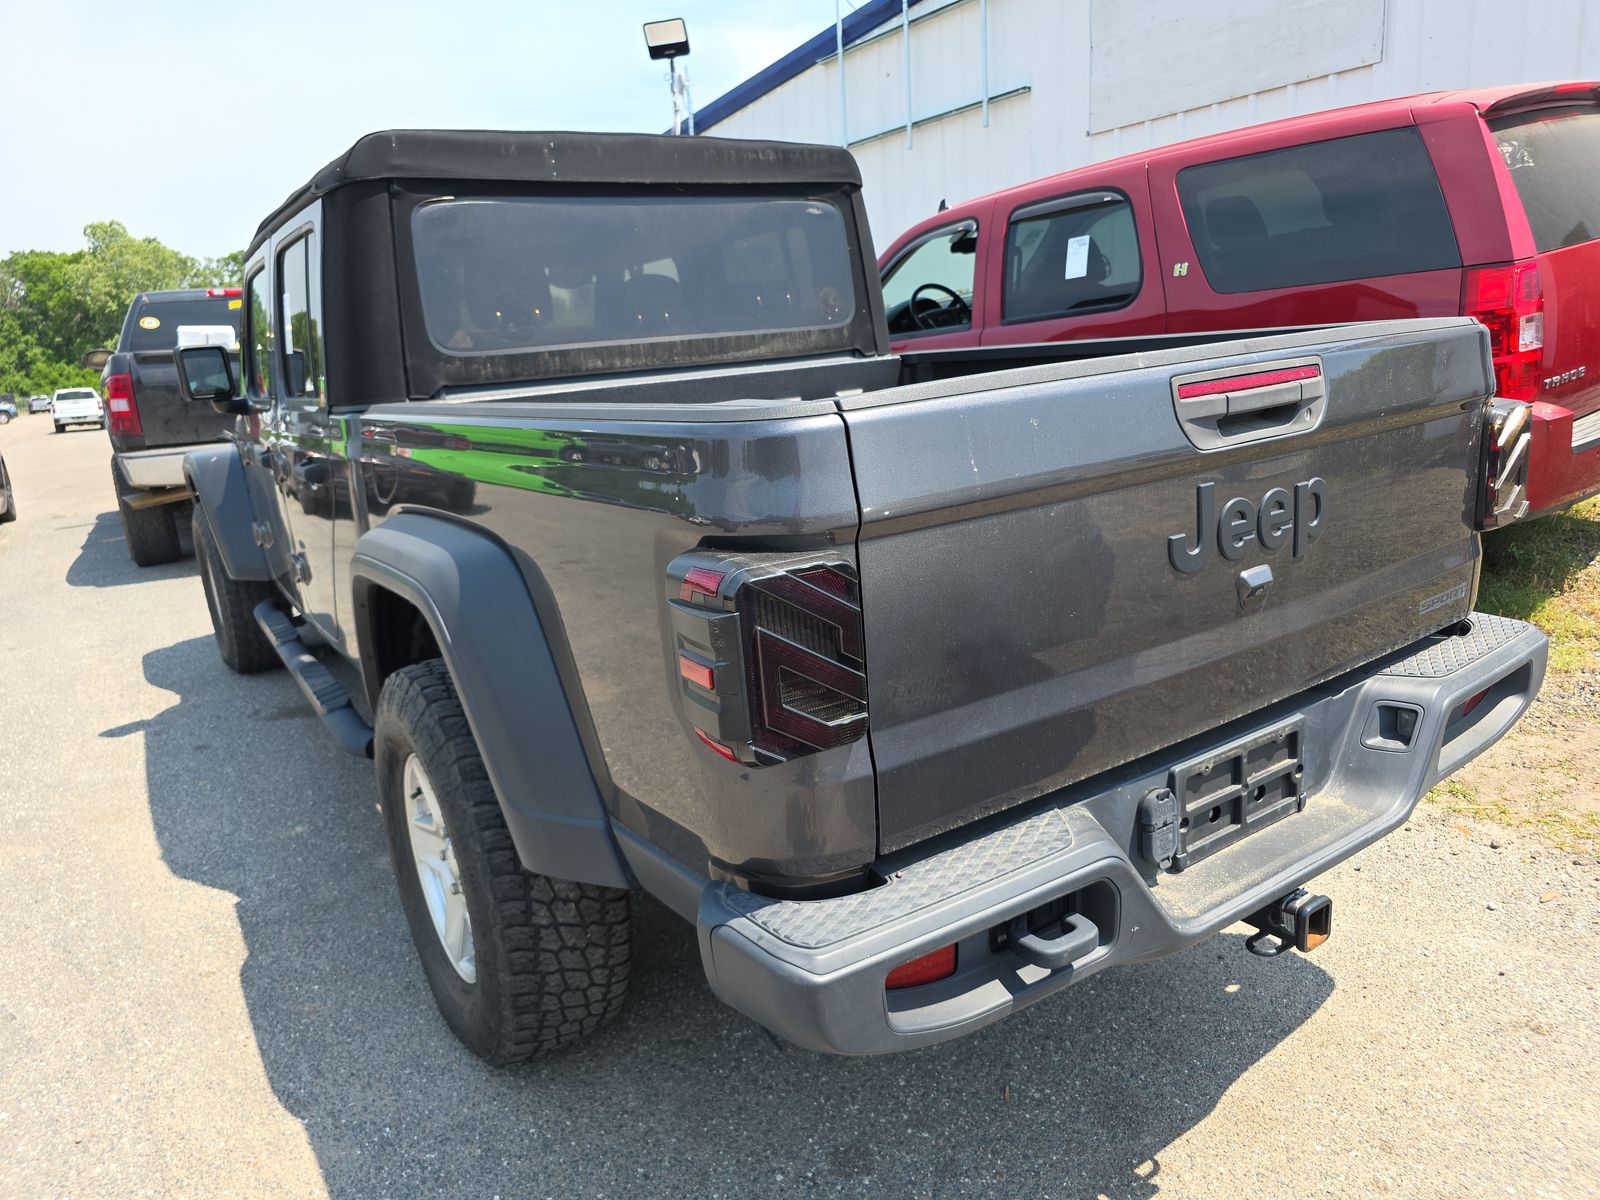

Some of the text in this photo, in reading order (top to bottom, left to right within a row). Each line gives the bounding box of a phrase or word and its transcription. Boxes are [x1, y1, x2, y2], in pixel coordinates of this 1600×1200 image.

[1543, 365, 1586, 389] TAHOE
[1168, 477, 1327, 573] Jeep
[1419, 583, 1466, 614] SPORT
